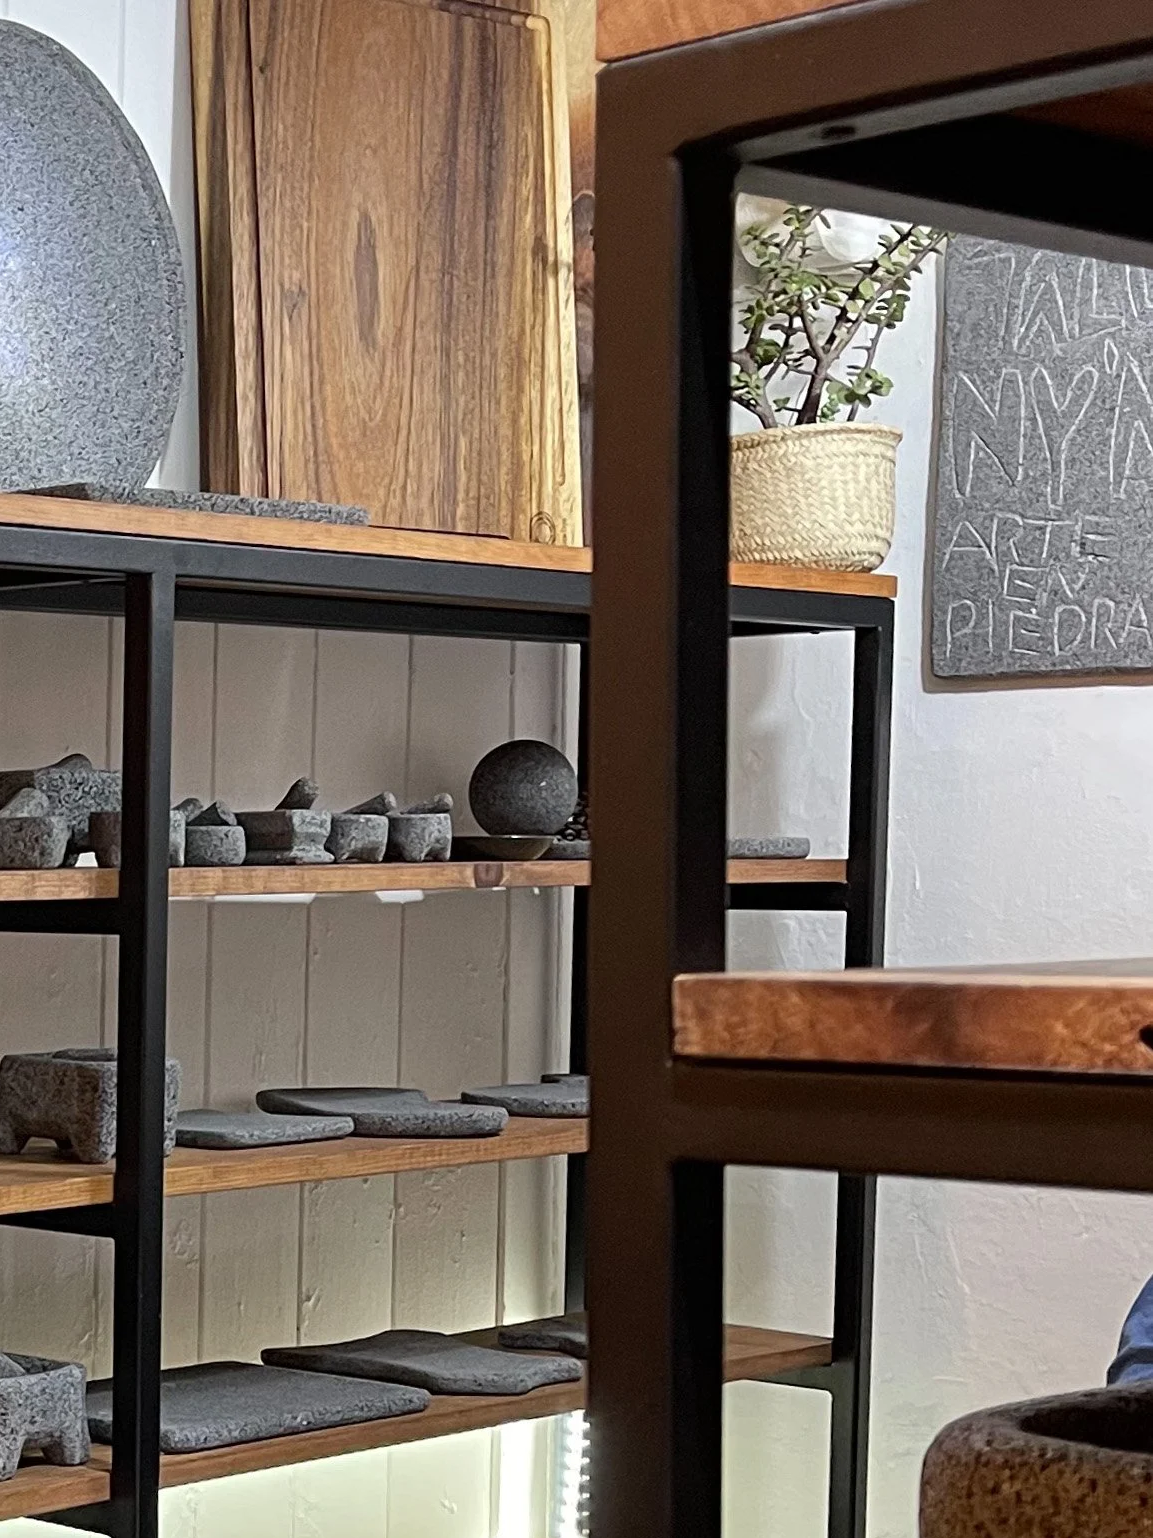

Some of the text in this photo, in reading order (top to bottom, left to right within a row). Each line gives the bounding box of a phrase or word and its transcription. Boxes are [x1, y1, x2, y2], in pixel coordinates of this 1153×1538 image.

[943, 511, 1117, 577] ARTE
[1004, 560, 1089, 602] EN
[947, 595, 1153, 657] PIEDRA
